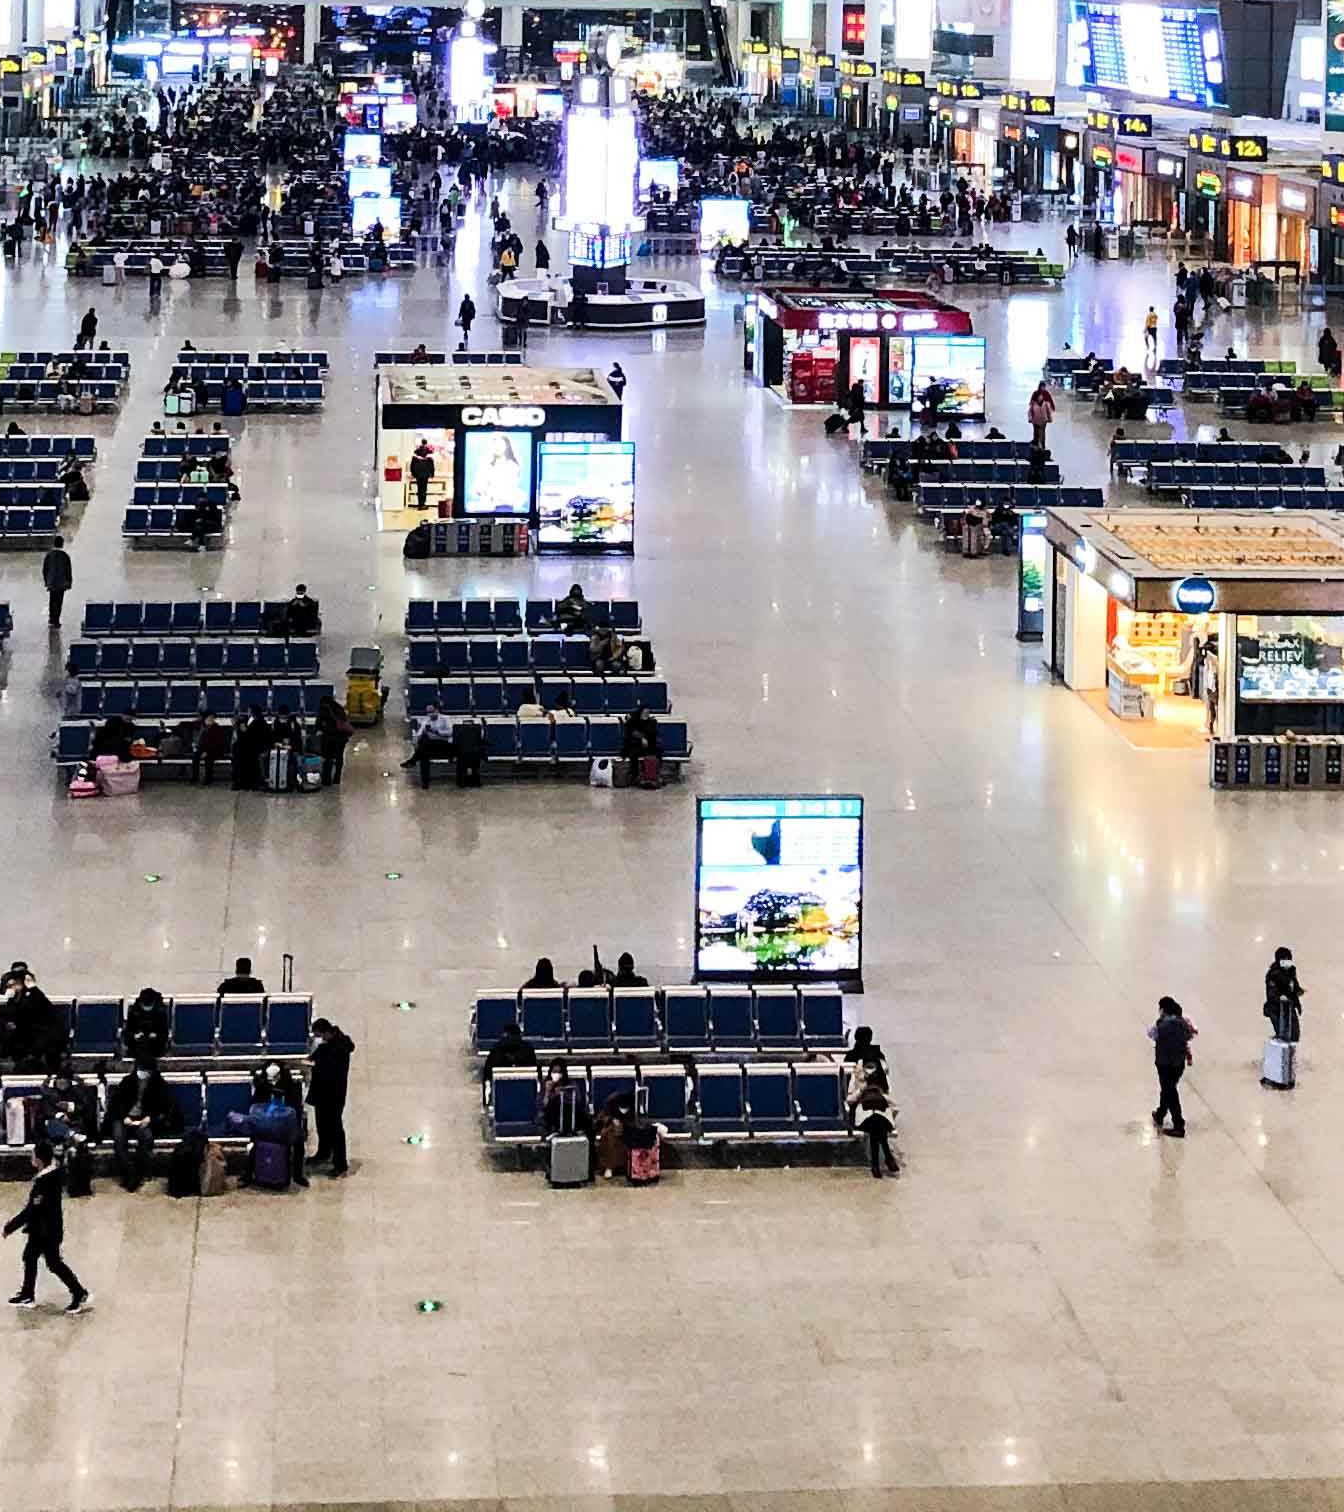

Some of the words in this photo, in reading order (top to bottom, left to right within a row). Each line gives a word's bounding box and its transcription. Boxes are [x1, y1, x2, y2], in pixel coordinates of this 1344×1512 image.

[1124, 118, 1147, 133] 14A
[1235, 140, 1262, 157] 12A
[461, 407, 546, 426] CASIO
